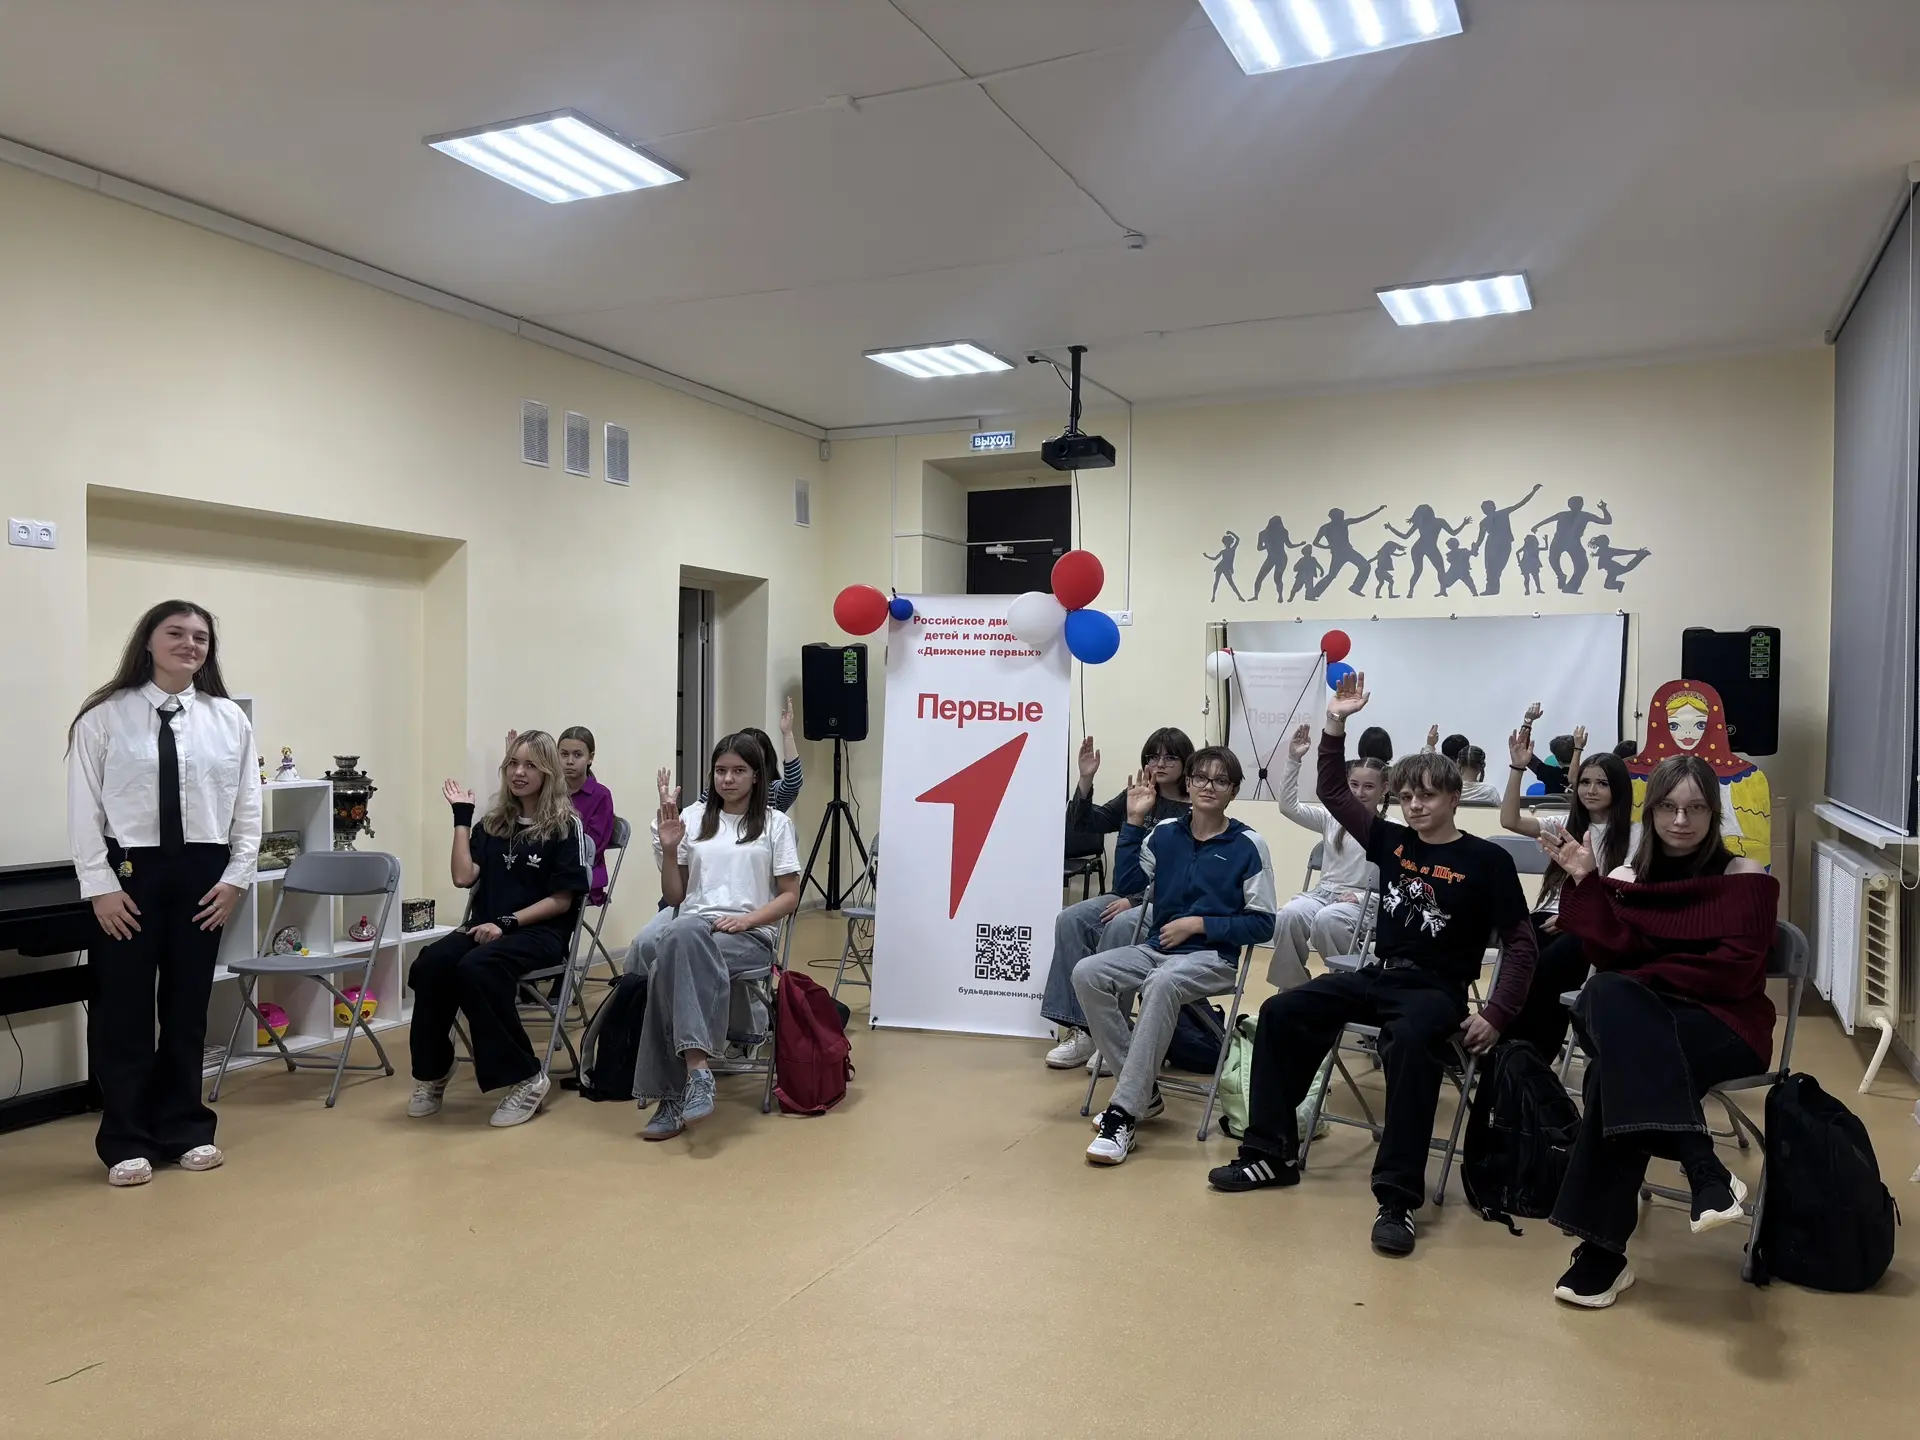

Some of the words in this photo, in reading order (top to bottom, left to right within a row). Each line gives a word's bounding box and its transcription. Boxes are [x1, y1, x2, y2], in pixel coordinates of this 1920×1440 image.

[974, 434, 1011, 447] ВЫХОД
[913, 615, 985, 626] Российское
[924, 631, 959, 641] детей
[962, 633, 970, 641] и
[917, 646, 986, 656] «Движение
[989, 648, 1042, 658] первых»
[917, 692, 1044, 729] Первые
[1248, 708, 1312, 729] Первые
[958, 987, 1044, 1000] будьвдвижении.рф
